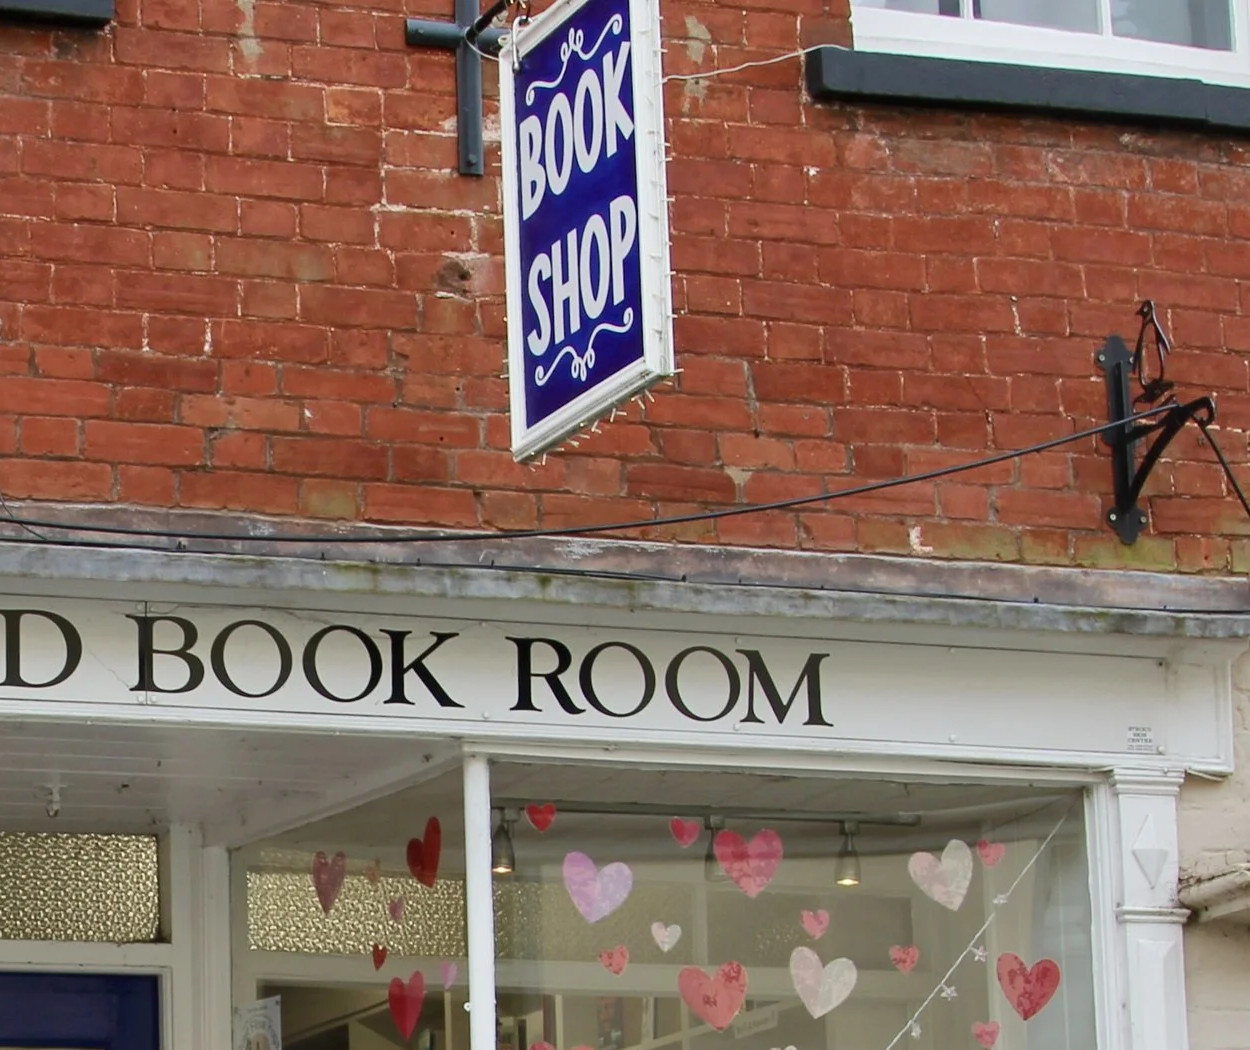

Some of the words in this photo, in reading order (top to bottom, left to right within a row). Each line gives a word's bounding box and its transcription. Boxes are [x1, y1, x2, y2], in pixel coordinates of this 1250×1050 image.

[519, 41, 635, 220] BOOK
[527, 195, 637, 356] SHOP
[125, 613, 465, 709] BOOK
[505, 636, 834, 727] ROOM
